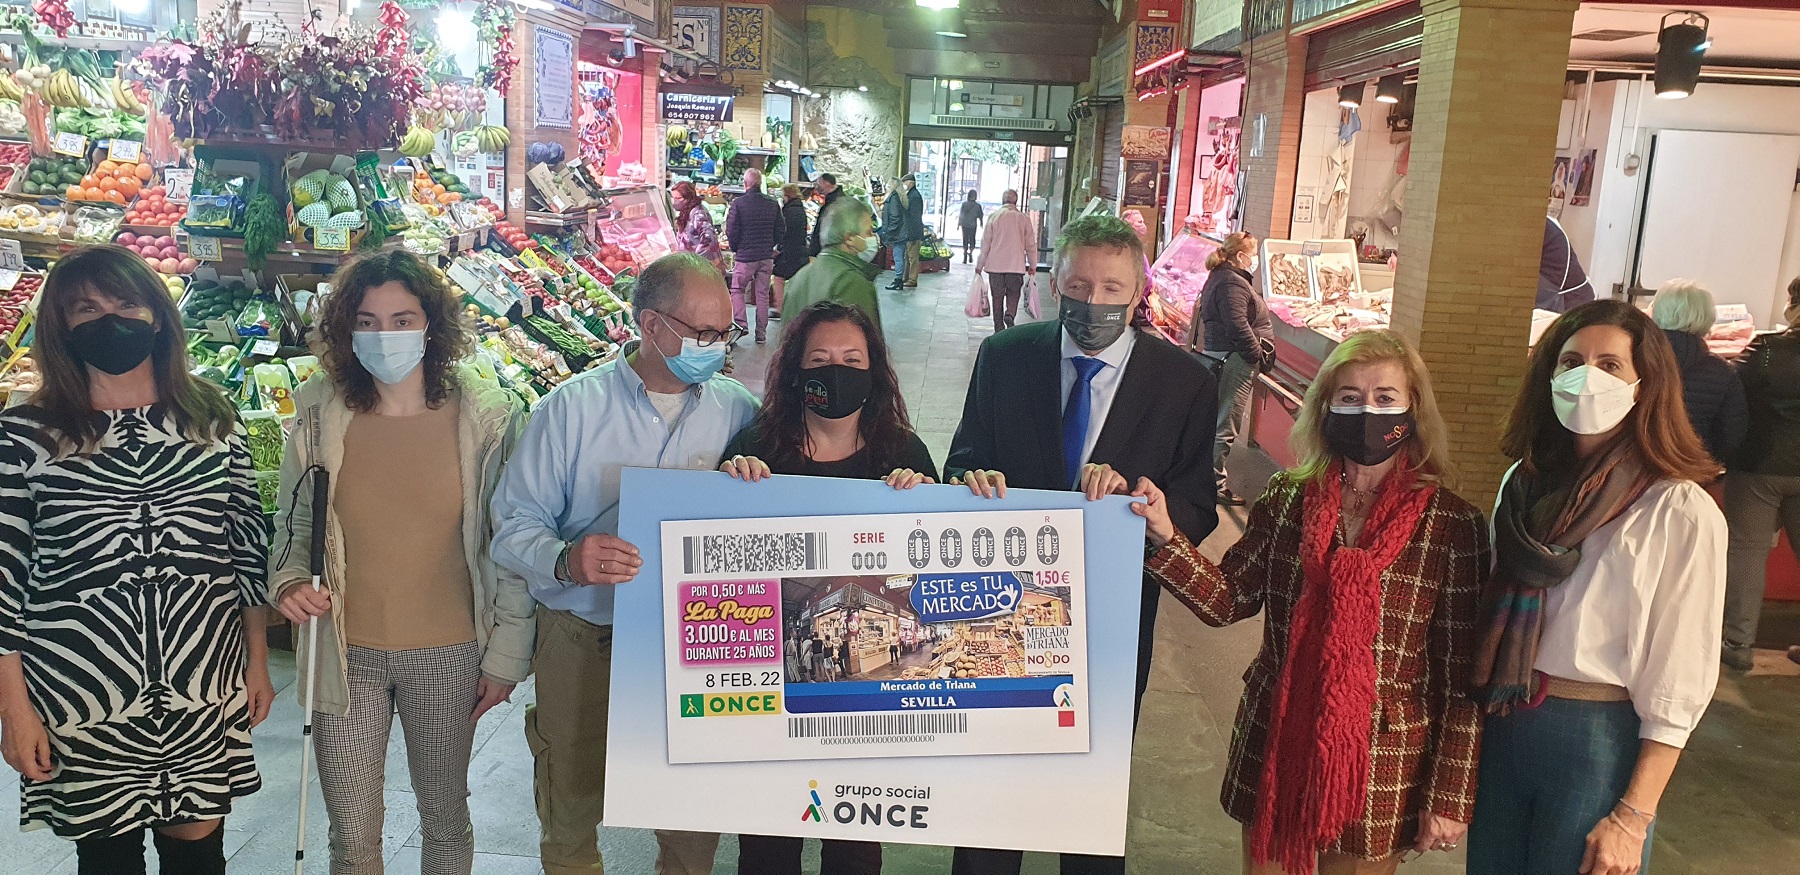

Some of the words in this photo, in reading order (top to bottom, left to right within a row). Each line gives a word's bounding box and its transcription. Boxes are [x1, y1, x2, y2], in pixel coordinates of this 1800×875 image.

[853, 532, 885, 544] SERIE
[691, 586, 708, 597] POR
[711, 583, 736, 599] 0,50
[738, 585, 744, 595] €
[747, 582, 766, 595] MÁS
[921, 579, 956, 596] ESTE
[960, 580, 977, 593] es
[981, 575, 1003, 592] TU
[922, 589, 1014, 615] MERCADO
[685, 624, 729, 644] 3.000
[730, 629, 737, 642] €
[739, 629, 752, 642] AL
[754, 628, 775, 642] MES
[1026, 627, 1069, 642] MERCADO
[686, 646, 731, 660] DURANTE
[733, 645, 746, 659] 25
[749, 643, 775, 658] AÑOS
[706, 673, 715, 688] 8
[721, 672, 757, 688] FEB.
[760, 671, 780, 686] 22
[880, 682, 926, 692] Mercado
[929, 681, 942, 690] de
[945, 680, 977, 690] Triana
[709, 695, 776, 713] ONCE
[901, 696, 957, 707] SEVILLA
[835, 784, 882, 799] grupo
[886, 786, 931, 800] social
[833, 801, 929, 829] ONCE
